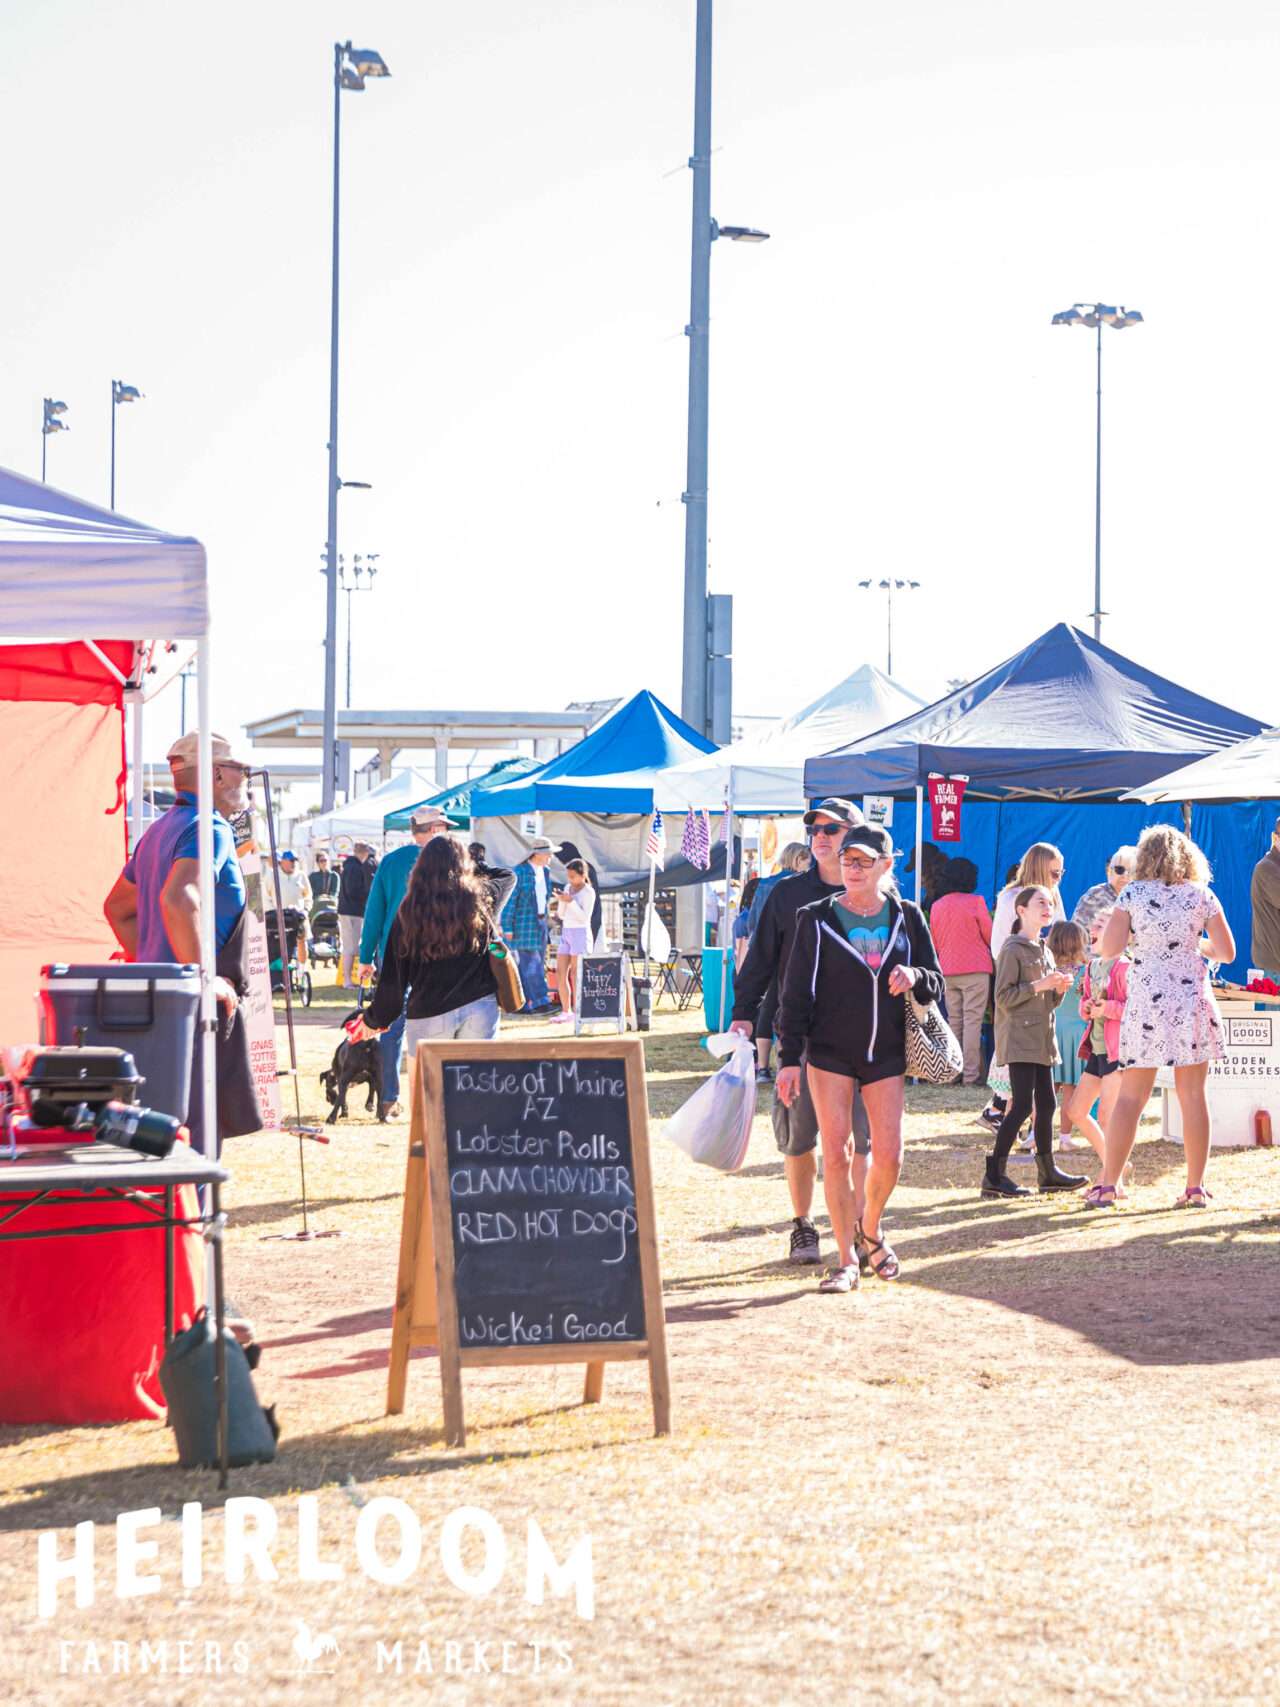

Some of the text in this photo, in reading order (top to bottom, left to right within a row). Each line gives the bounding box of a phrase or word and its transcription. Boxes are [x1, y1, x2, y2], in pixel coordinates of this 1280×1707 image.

[936, 784, 955, 795] REAL
[1233, 1029, 1268, 1037] GOODS
[1215, 1056, 1266, 1065] OODEN
[445, 1060, 626, 1097] Taste of Maine
[523, 1095, 559, 1121] AZ
[457, 1124, 620, 1160] Lobster Rolls
[451, 1165, 635, 1196] CLAM CHOWDER
[458, 1212, 517, 1243] RED
[525, 1209, 563, 1240] HOT
[462, 1311, 636, 1342] Wicked Good
